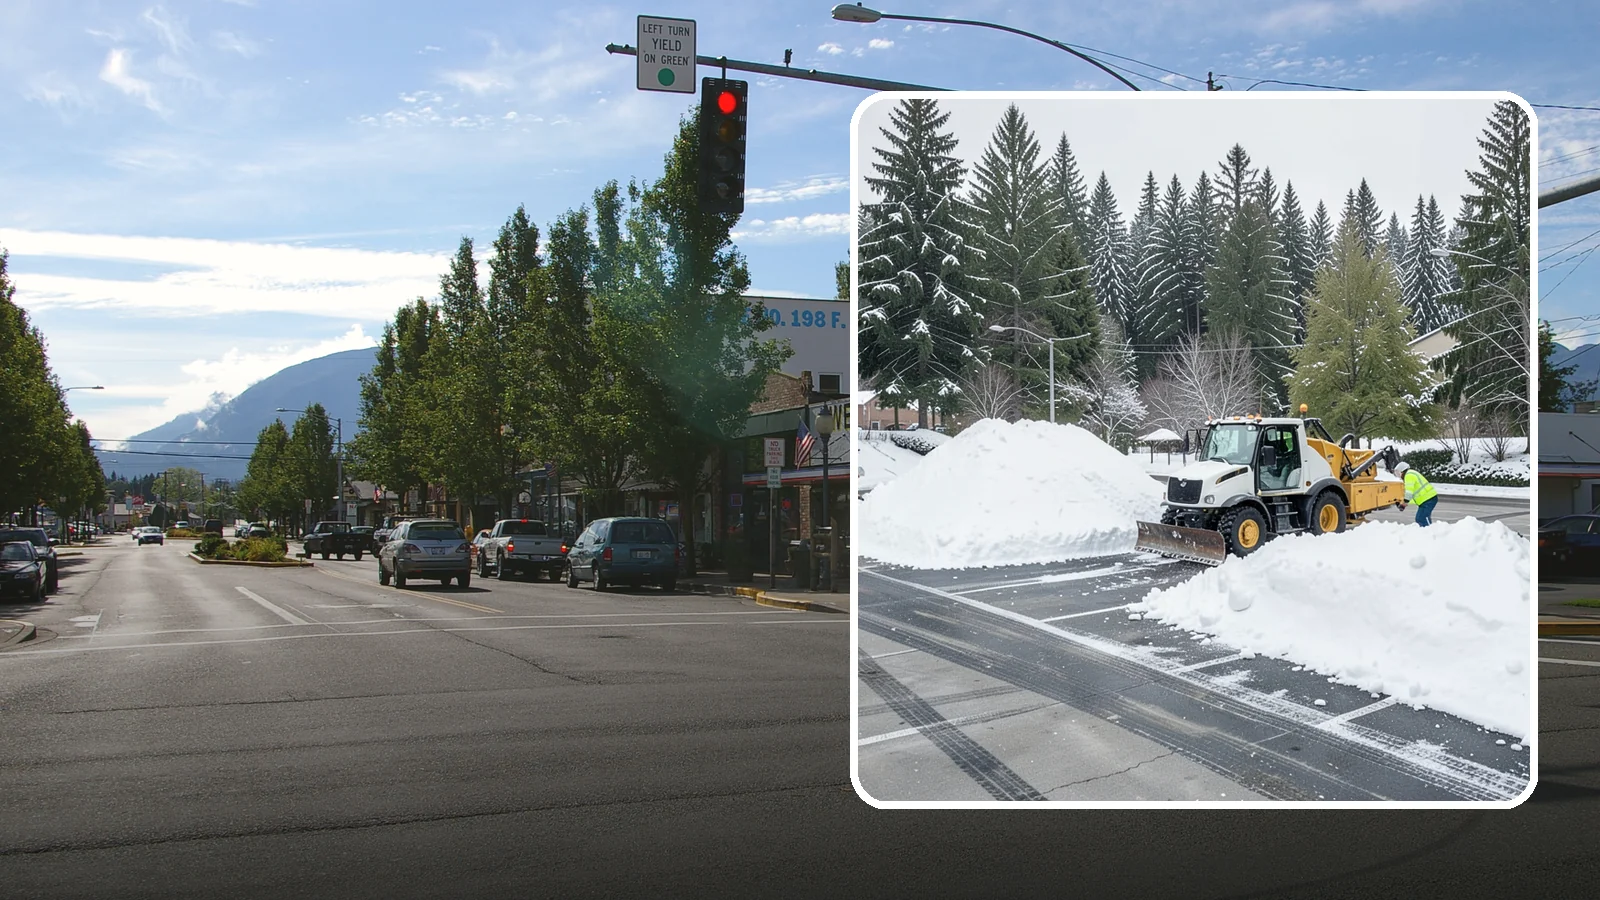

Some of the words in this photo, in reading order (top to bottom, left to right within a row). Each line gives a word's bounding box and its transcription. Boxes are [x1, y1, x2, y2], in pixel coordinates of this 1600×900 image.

[643, 24, 663, 34] LEFT
[668, 26, 690, 36] TURN
[652, 38, 682, 51] YIELD
[644, 53, 656, 63] ON
[661, 55, 689, 66] GREEN
[791, 309, 826, 327] 198
[831, 312, 846, 329] F.
